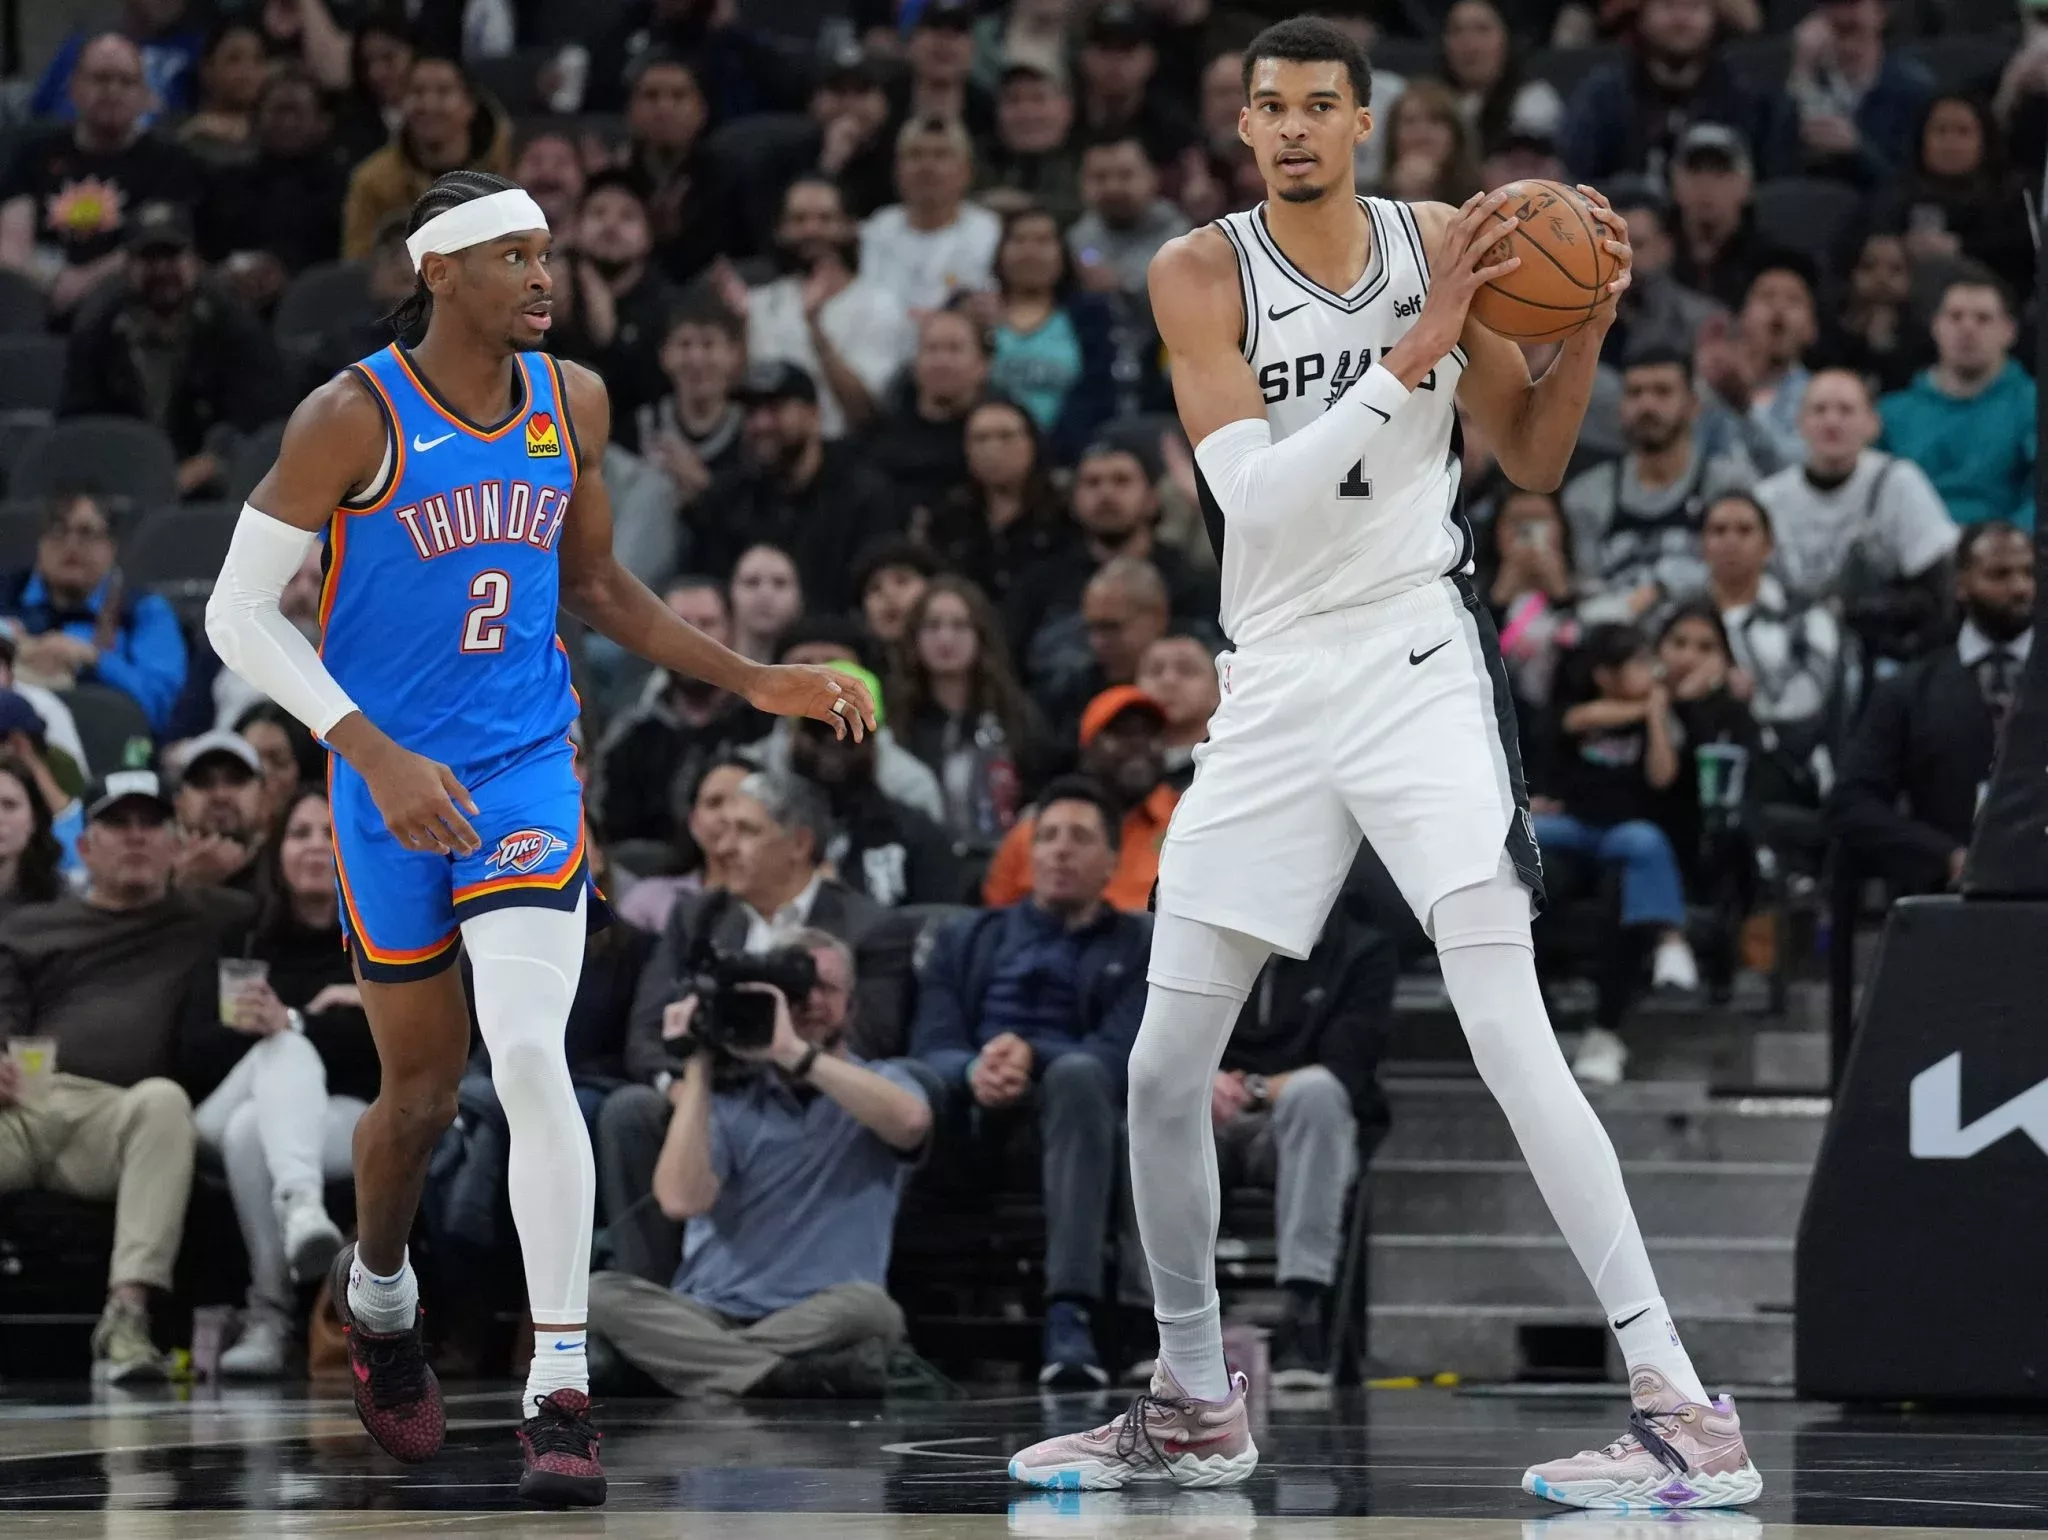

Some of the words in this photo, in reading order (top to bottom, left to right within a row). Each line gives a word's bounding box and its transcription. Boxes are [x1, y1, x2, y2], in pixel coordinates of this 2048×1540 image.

[1393, 294, 1421, 318] Self
[395, 480, 570, 561] THUNDER
[460, 568, 512, 654] 2
[499, 836, 541, 867] OKC
